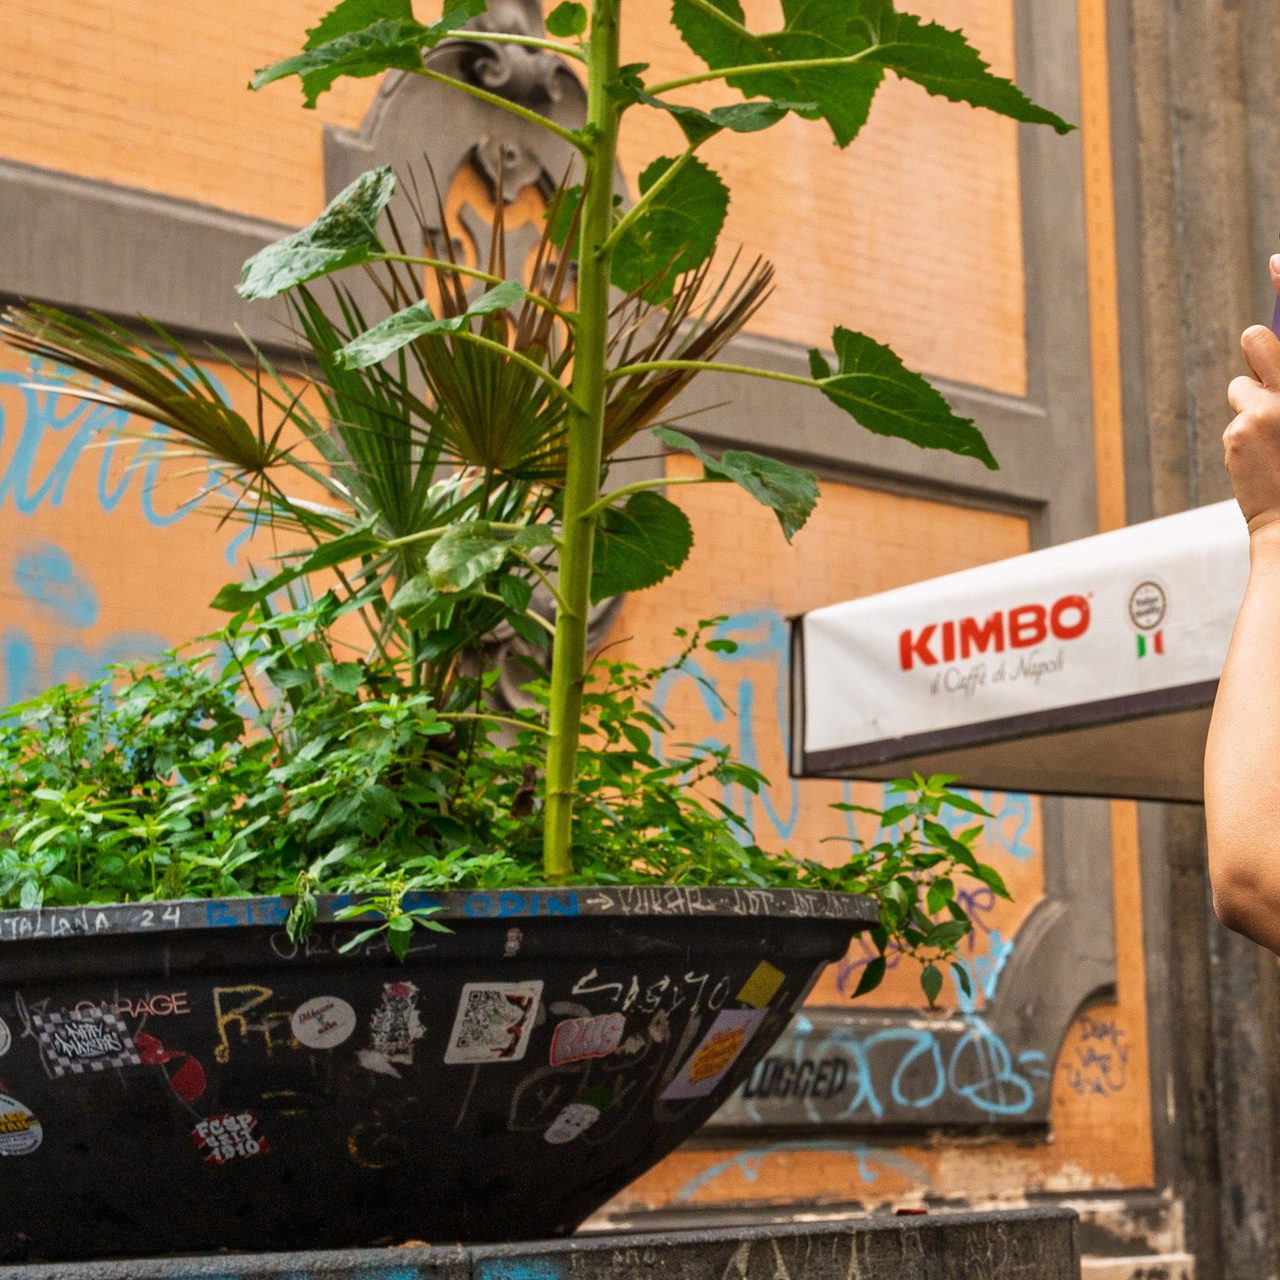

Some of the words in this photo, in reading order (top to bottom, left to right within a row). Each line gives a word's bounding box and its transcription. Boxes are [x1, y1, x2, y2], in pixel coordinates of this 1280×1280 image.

[900, 594, 1092, 671] KIMBO
[140, 906, 181, 929] 24
[463, 891, 581, 918] ODIN
